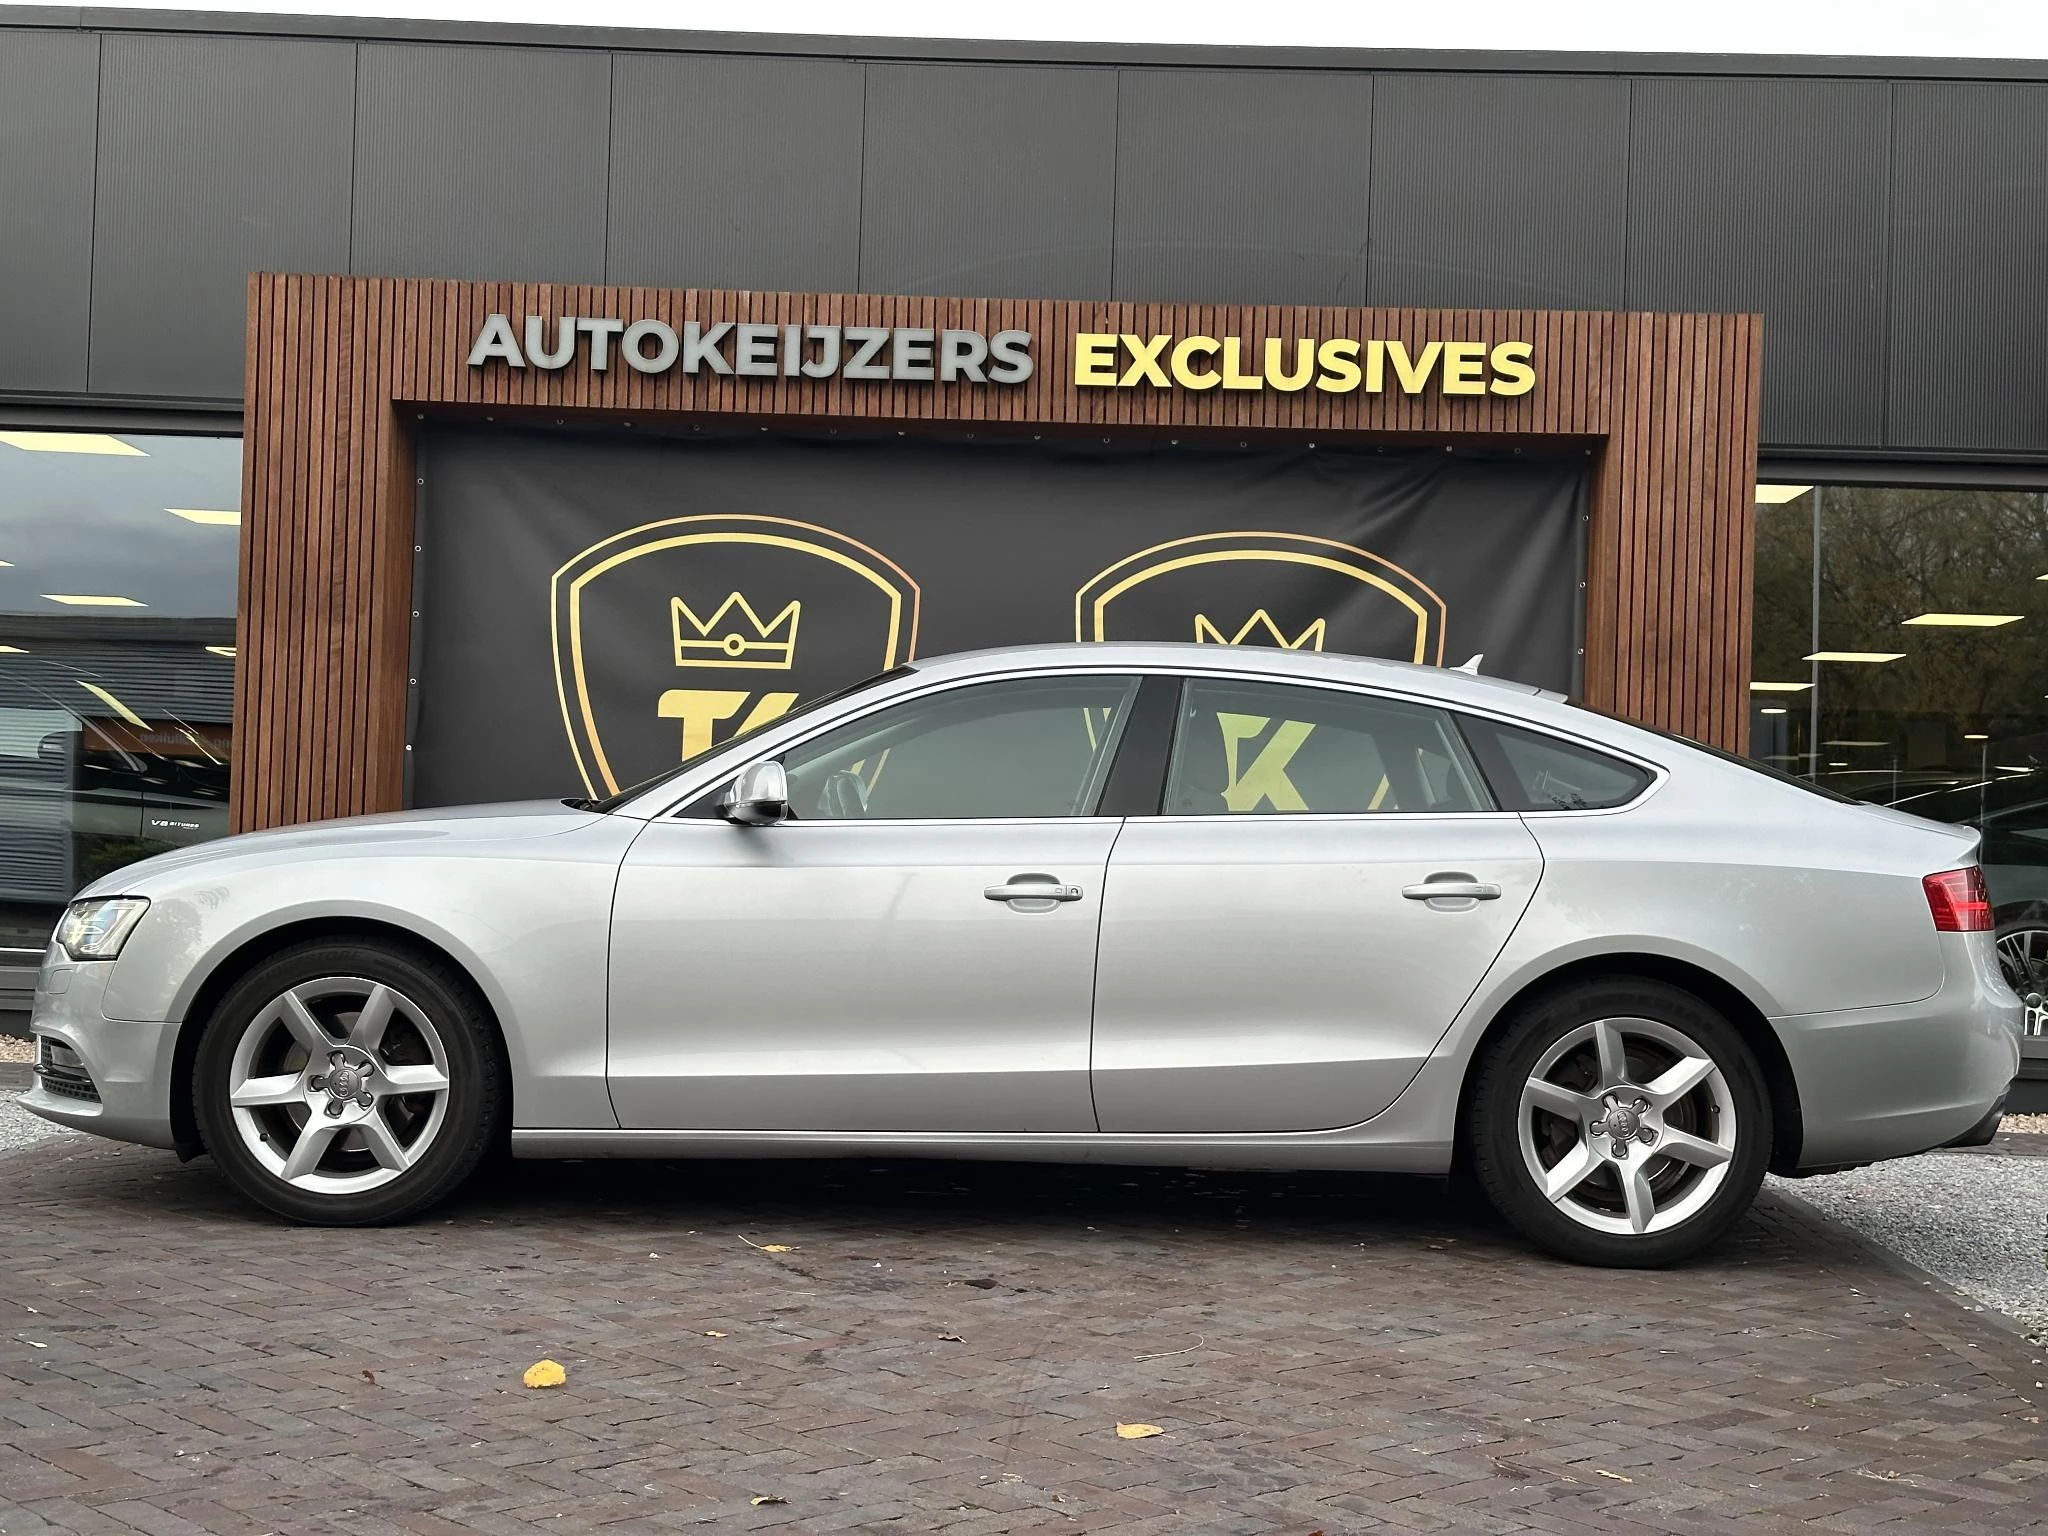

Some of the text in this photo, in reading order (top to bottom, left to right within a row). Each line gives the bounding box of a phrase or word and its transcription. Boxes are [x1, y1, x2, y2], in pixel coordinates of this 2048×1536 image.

[466, 313, 1536, 397] AUTOKEIJZERS EXCLUSIVES
[151, 819, 169, 827] V8
